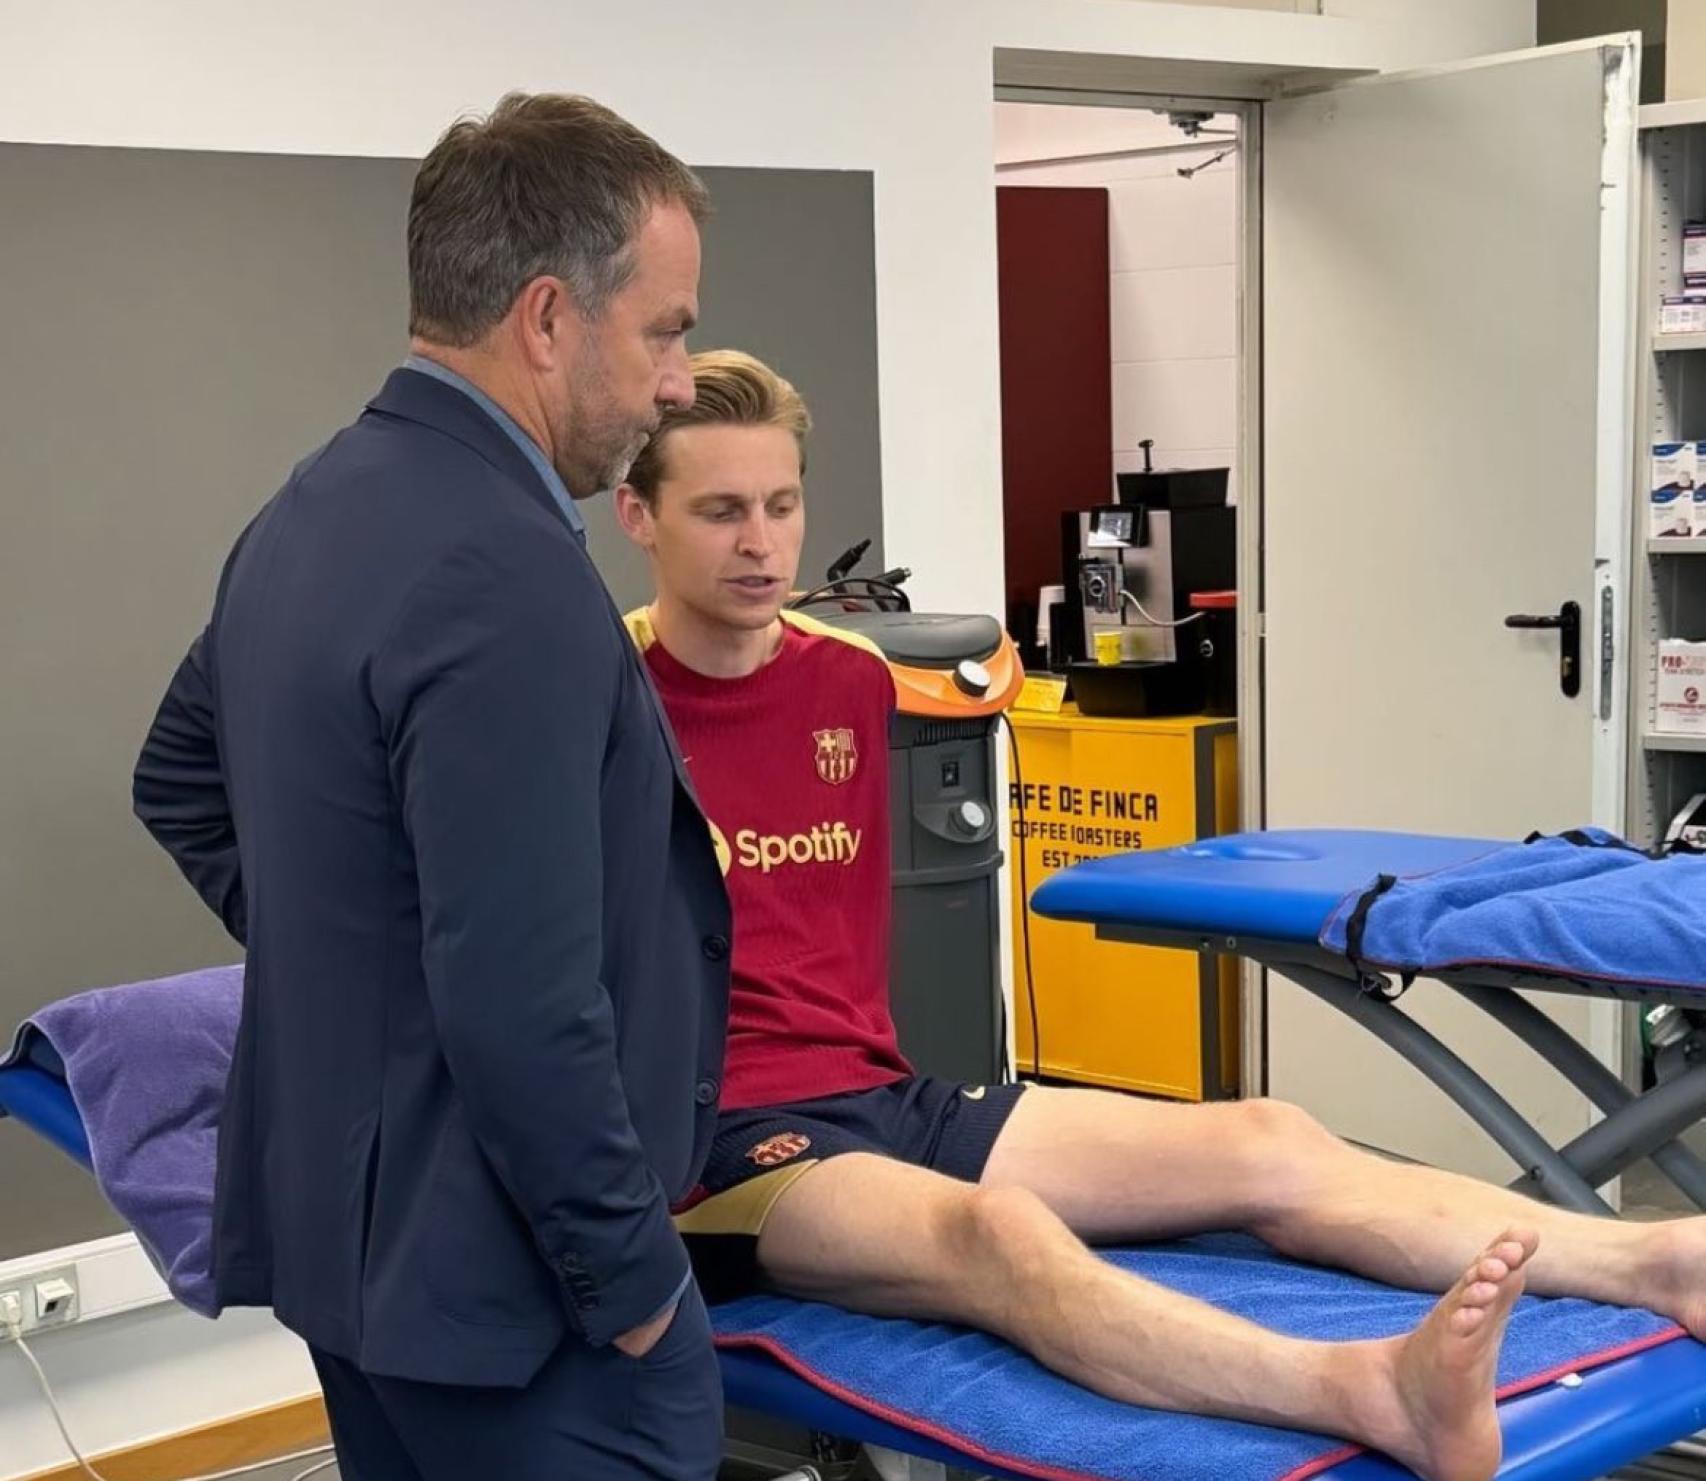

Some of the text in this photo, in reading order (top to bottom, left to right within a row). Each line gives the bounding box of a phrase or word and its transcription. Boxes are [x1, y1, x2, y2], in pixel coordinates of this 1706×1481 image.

[1059, 786, 1083, 815] DE
[1091, 790, 1158, 822] FINCA
[1012, 819, 1067, 841] COFFEE
[736, 821, 862, 873] Spotify
[1042, 850, 1070, 868] EST
